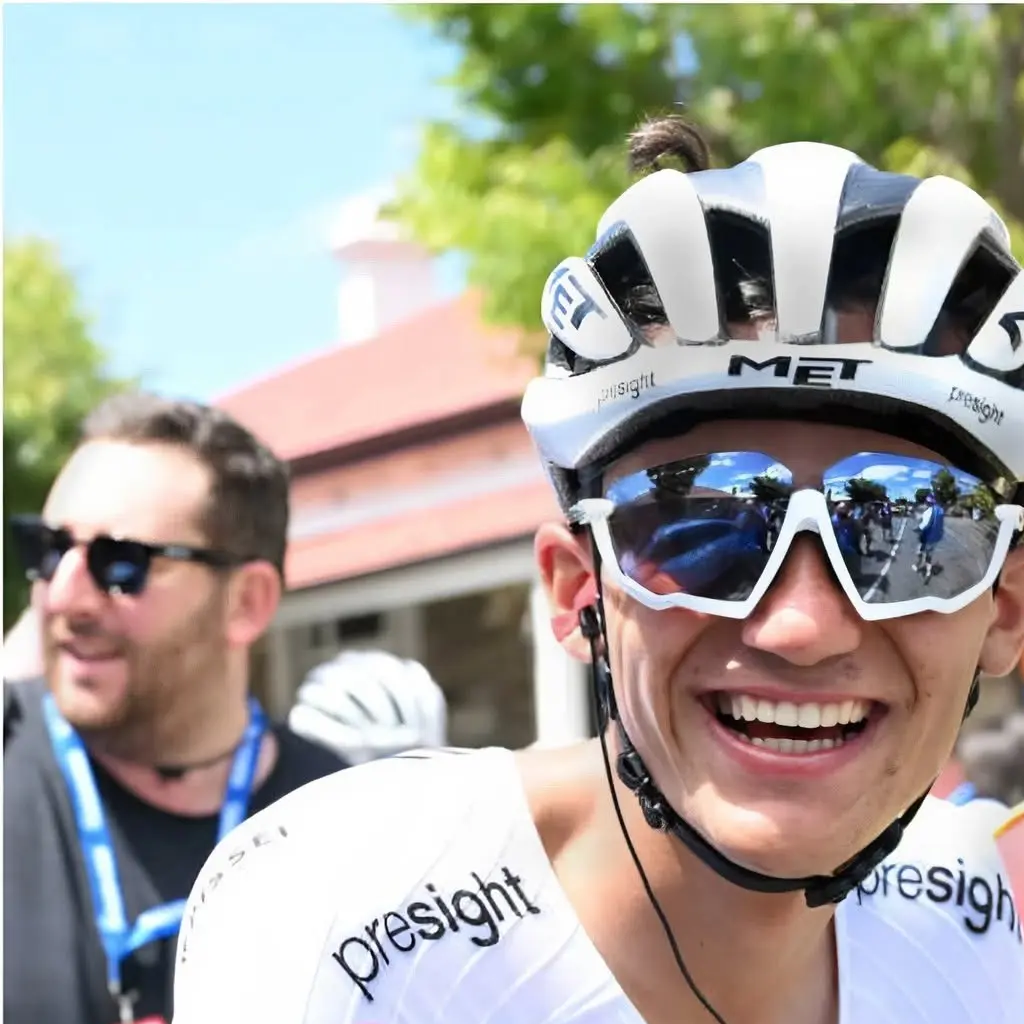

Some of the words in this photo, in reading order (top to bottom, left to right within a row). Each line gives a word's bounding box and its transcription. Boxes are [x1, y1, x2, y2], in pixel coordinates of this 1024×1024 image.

[727, 354, 874, 387] MET
[331, 866, 541, 1003] presight
[857, 857, 1023, 944] presigh
